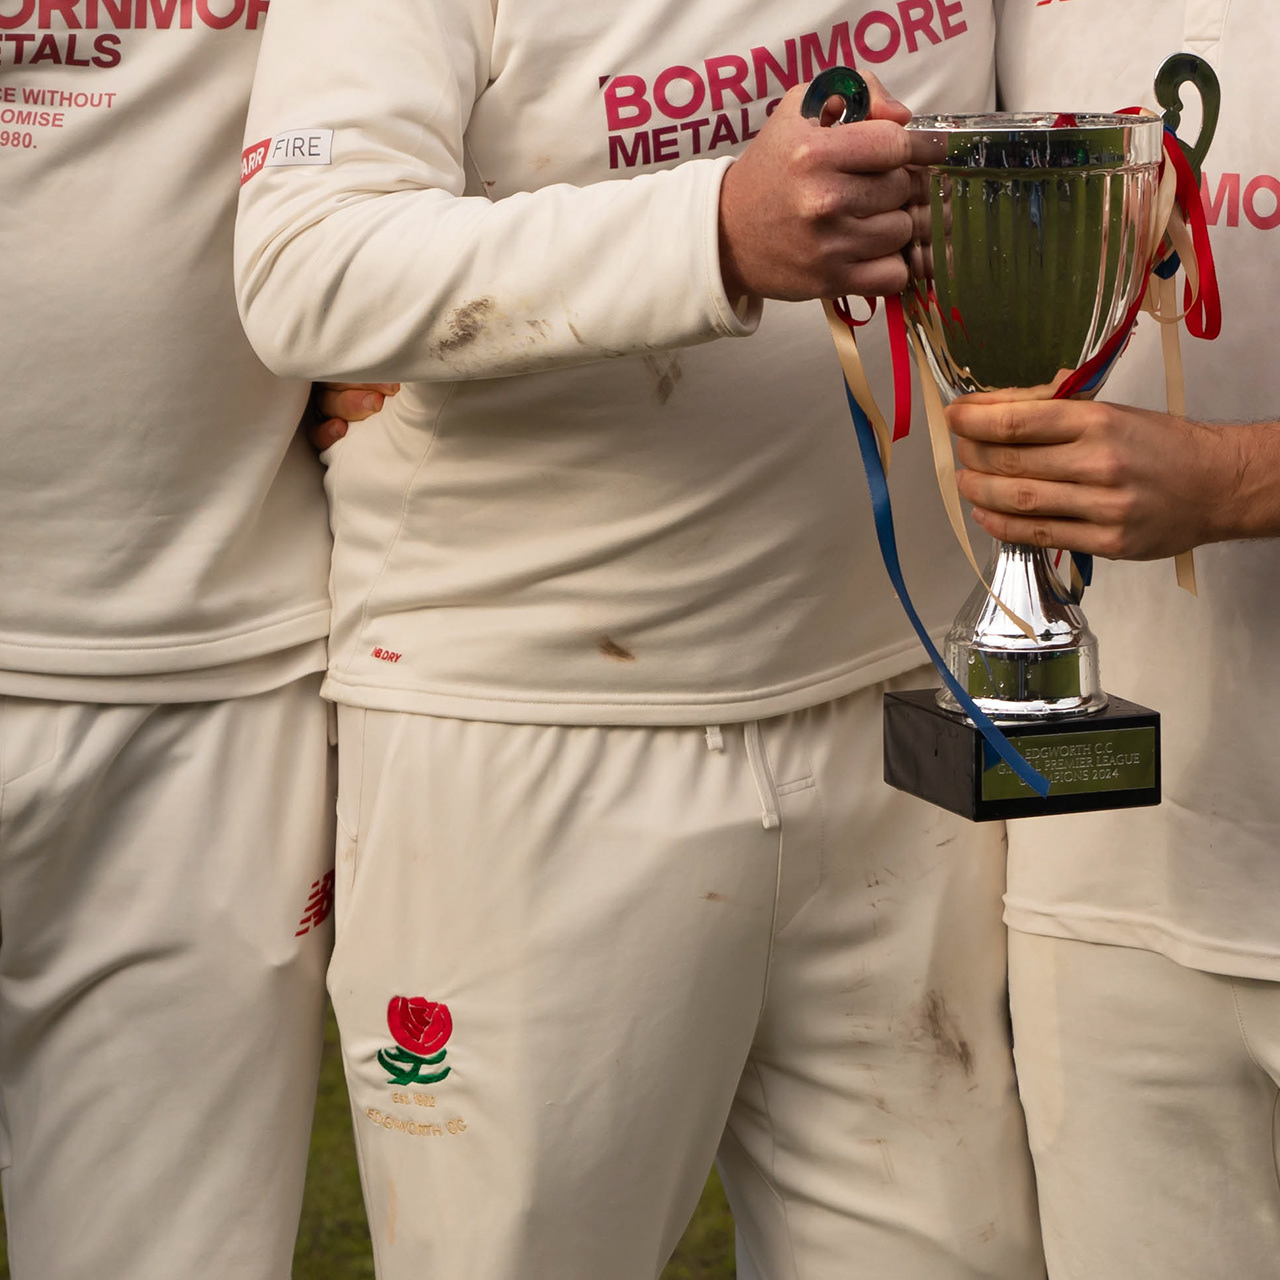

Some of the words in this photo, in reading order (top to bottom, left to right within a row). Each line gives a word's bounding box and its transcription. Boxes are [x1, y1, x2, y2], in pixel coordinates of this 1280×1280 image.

[22, 88, 117, 109] WITHOUT
[240, 147, 265, 179] ARR
[272, 136, 322, 159] FIRE
[1025, 743, 1092, 760] EDGWORTH
[1044, 756, 1093, 771] PREMIER
[1096, 752, 1140, 767] LEAGUE
[1092, 767, 1120, 780] 2024
[365, 1107, 443, 1137] EDGWORTH
[446, 1117, 467, 1135] CC
